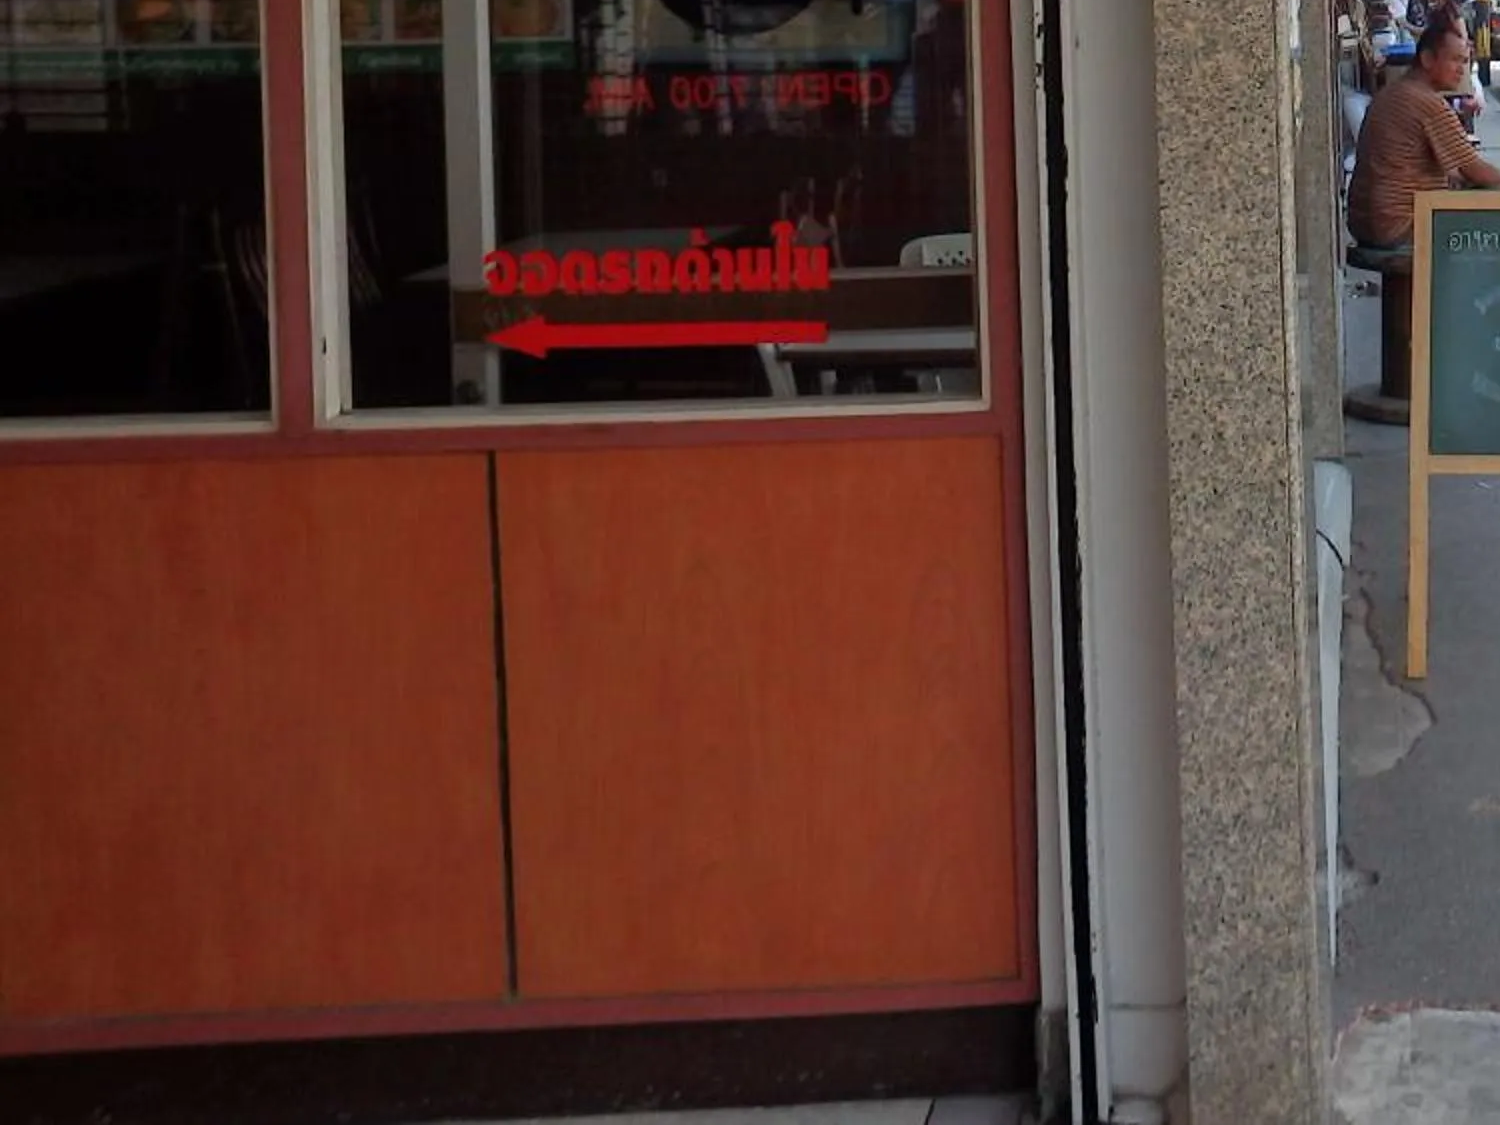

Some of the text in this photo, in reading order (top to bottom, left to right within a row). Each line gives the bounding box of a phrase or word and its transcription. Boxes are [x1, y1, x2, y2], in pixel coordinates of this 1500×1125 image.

[483, 221, 830, 295] จอดรถด้านใน
